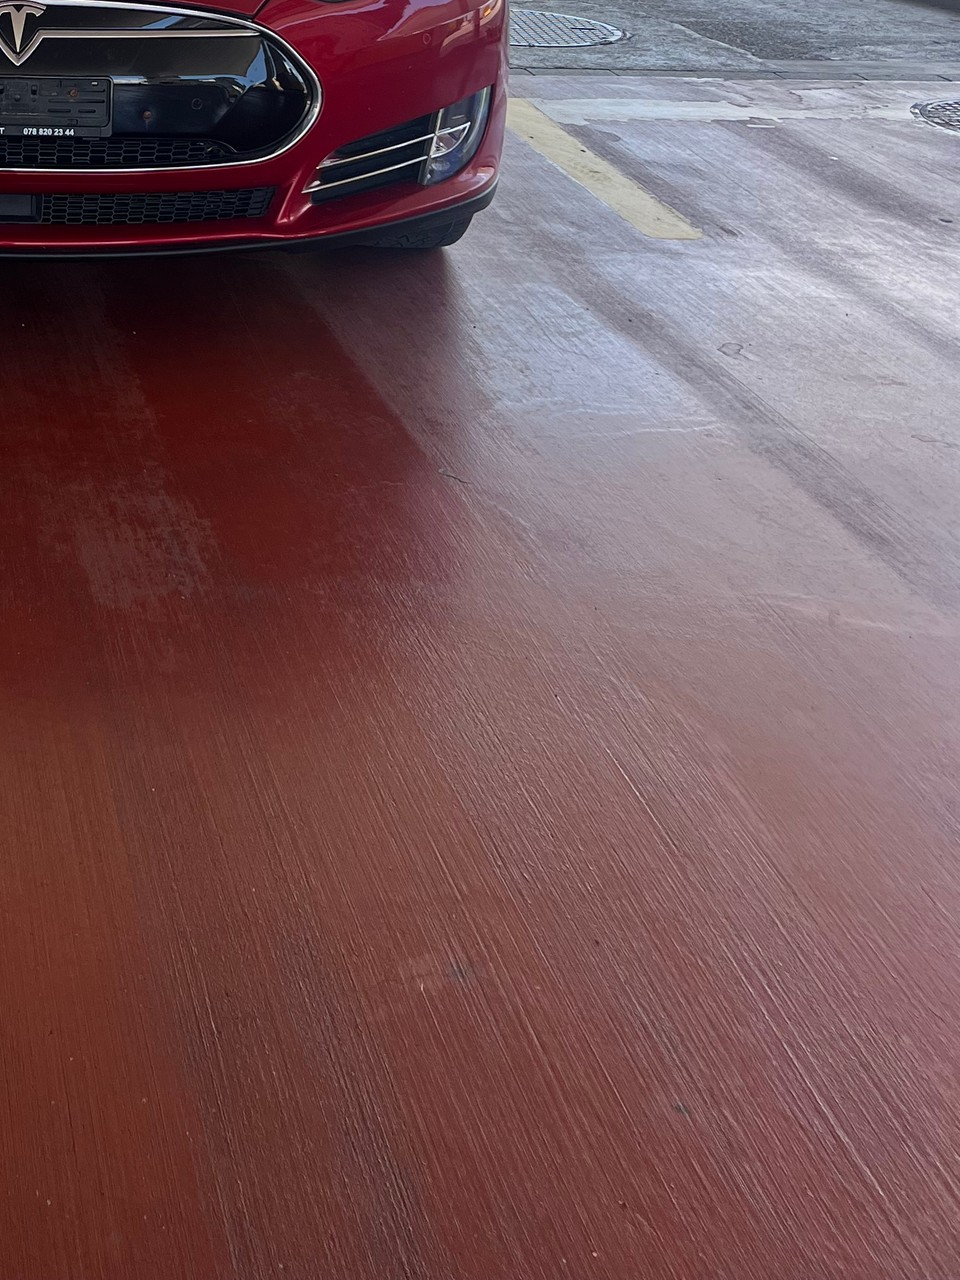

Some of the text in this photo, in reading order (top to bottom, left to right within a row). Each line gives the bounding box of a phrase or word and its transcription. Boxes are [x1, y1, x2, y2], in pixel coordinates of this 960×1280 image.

[23, 127, 75, 136] 078 820 23 44
